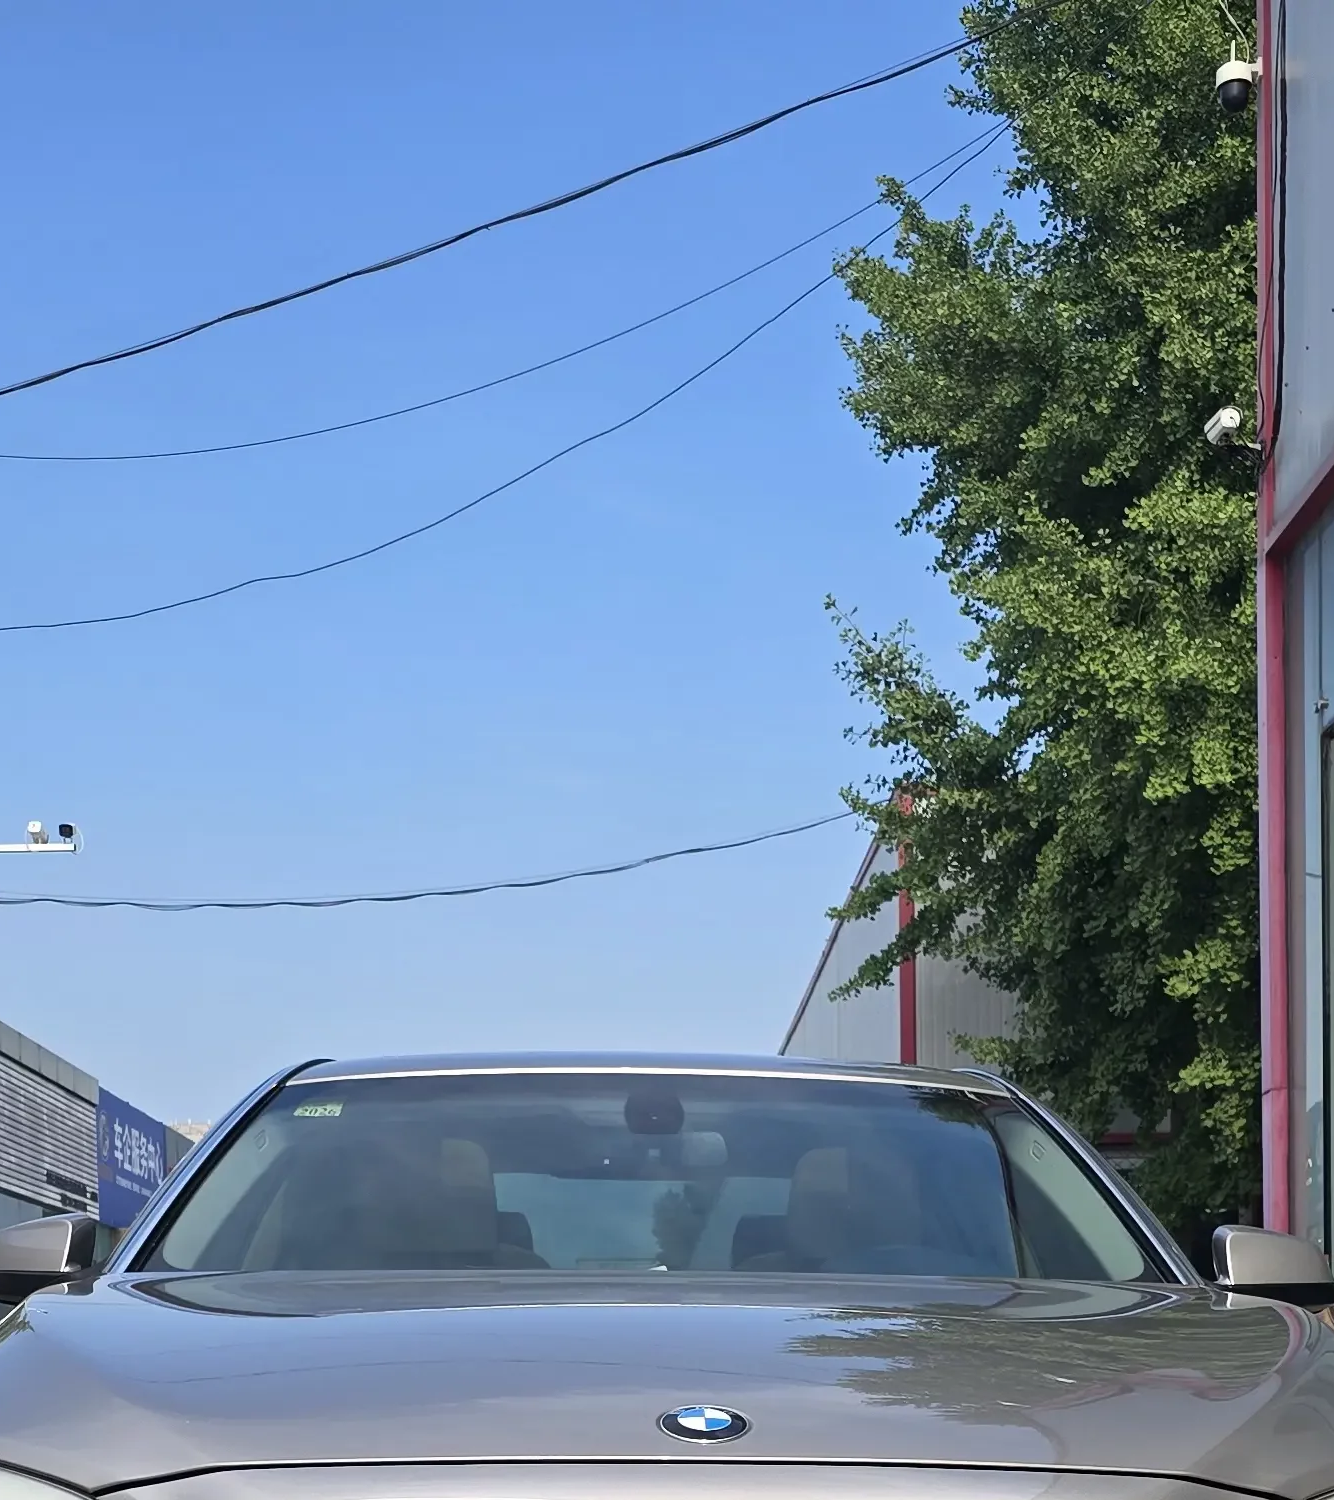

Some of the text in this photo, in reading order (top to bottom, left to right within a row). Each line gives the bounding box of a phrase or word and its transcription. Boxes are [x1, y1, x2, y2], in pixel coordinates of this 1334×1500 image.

[113, 1117, 165, 1187] 车企服务中心
